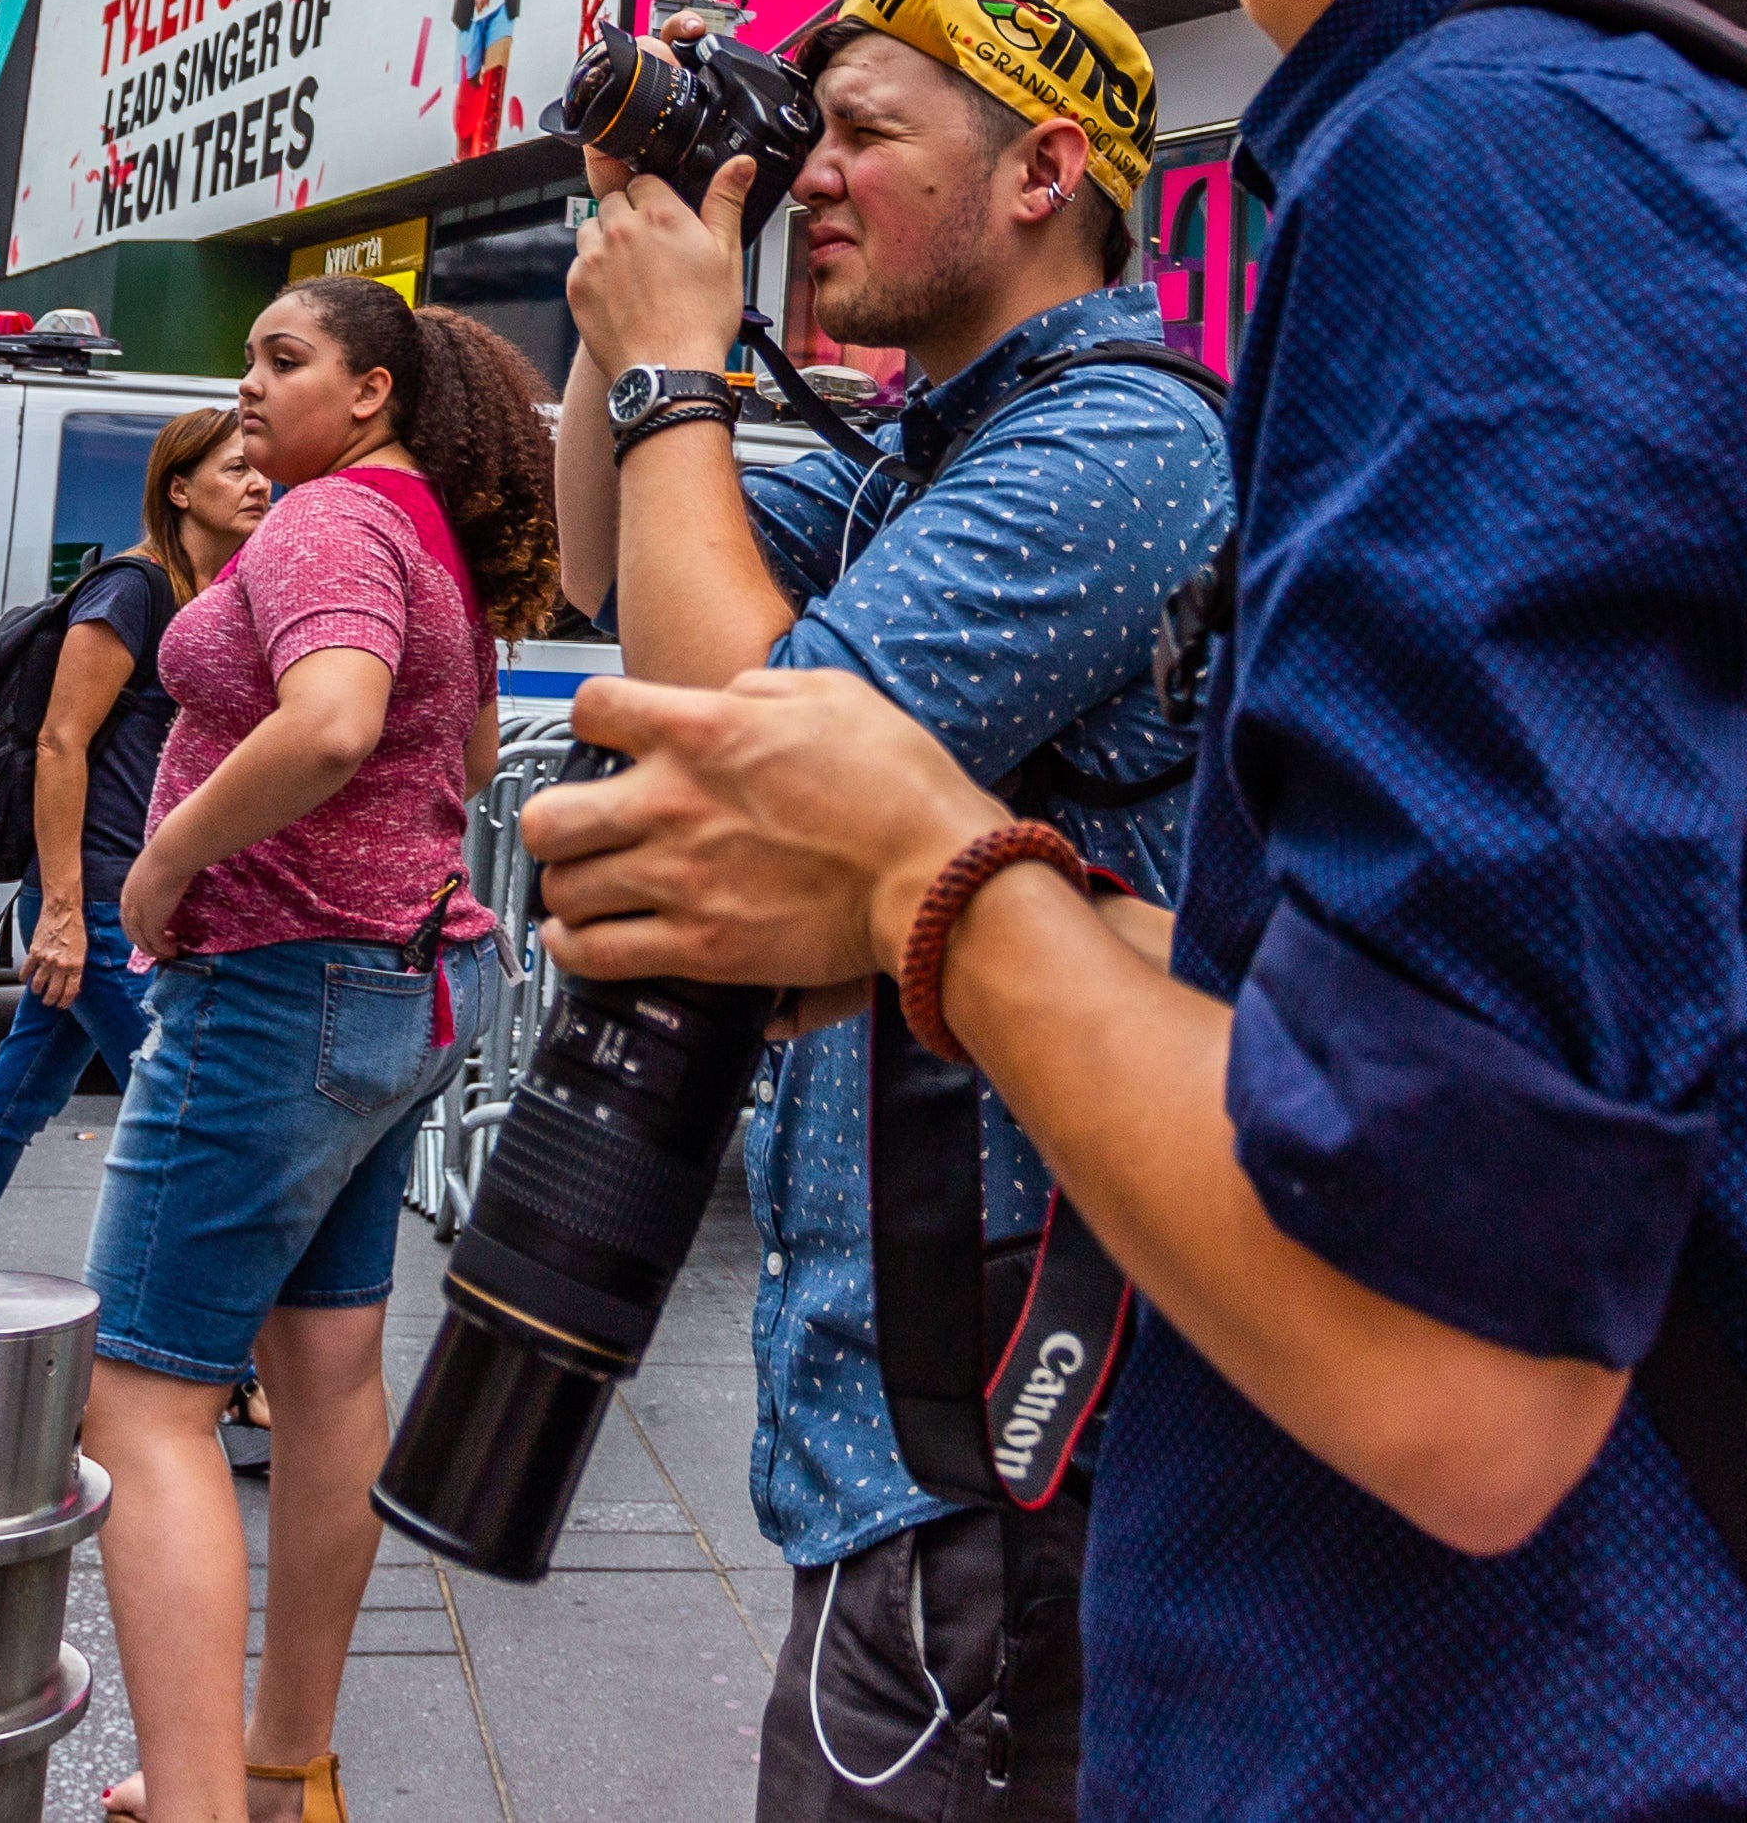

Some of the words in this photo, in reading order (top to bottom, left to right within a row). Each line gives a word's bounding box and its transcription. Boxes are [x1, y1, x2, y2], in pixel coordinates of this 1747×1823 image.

[95, 126, 184, 235] NEON
[193, 75, 318, 203] TREES
[101, 59, 165, 145] LEAD
[975, 40, 1070, 114] GRANDE
[1080, 117, 1144, 185] CICLISM
[993, 1331, 1086, 1481] Canon
